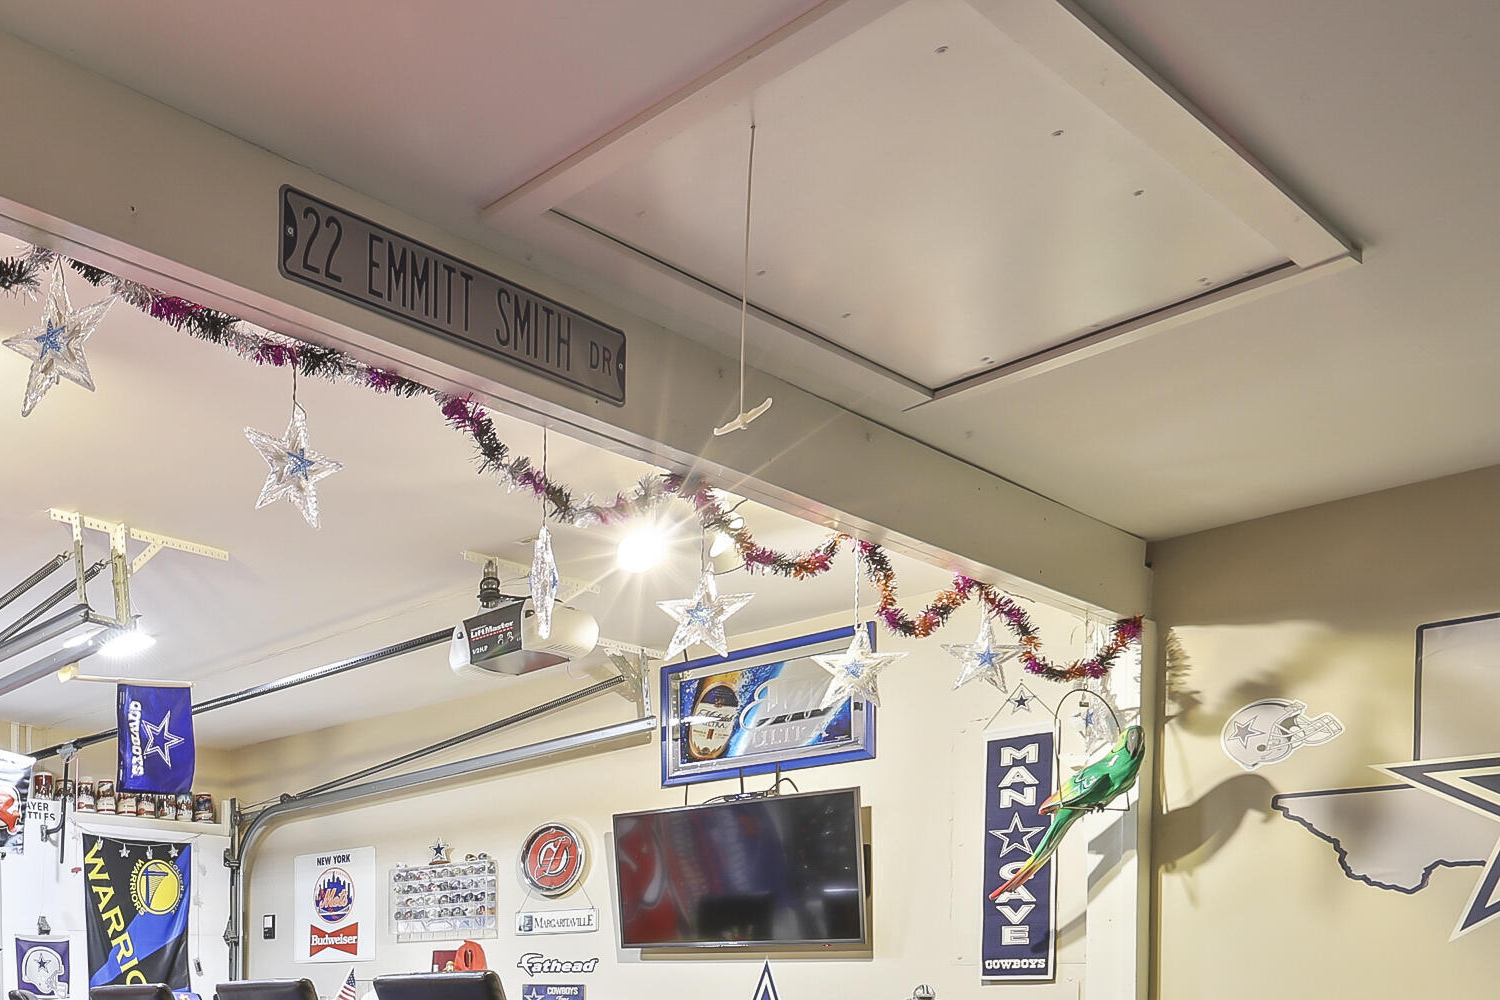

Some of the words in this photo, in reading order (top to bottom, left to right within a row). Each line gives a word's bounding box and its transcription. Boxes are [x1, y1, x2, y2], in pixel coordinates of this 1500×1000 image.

[302, 207, 343, 283] 22
[366, 232, 474, 332] EMMITT
[495, 287, 572, 372] SMITH
[589, 339, 613, 377] DR
[470, 620, 514, 639] LiftMaster
[998, 743, 1039, 808] MAN
[316, 857, 331, 867] NEW
[333, 854, 351, 864] YORK
[129, 859, 145, 916] WARRIORS
[995, 861, 1036, 945] CAVE
[311, 934, 358, 946] Budweiser
[517, 953, 599, 977] Fathead
[985, 959, 1045, 969] COWBOYS
[547, 987, 579, 995] COWBOYS
